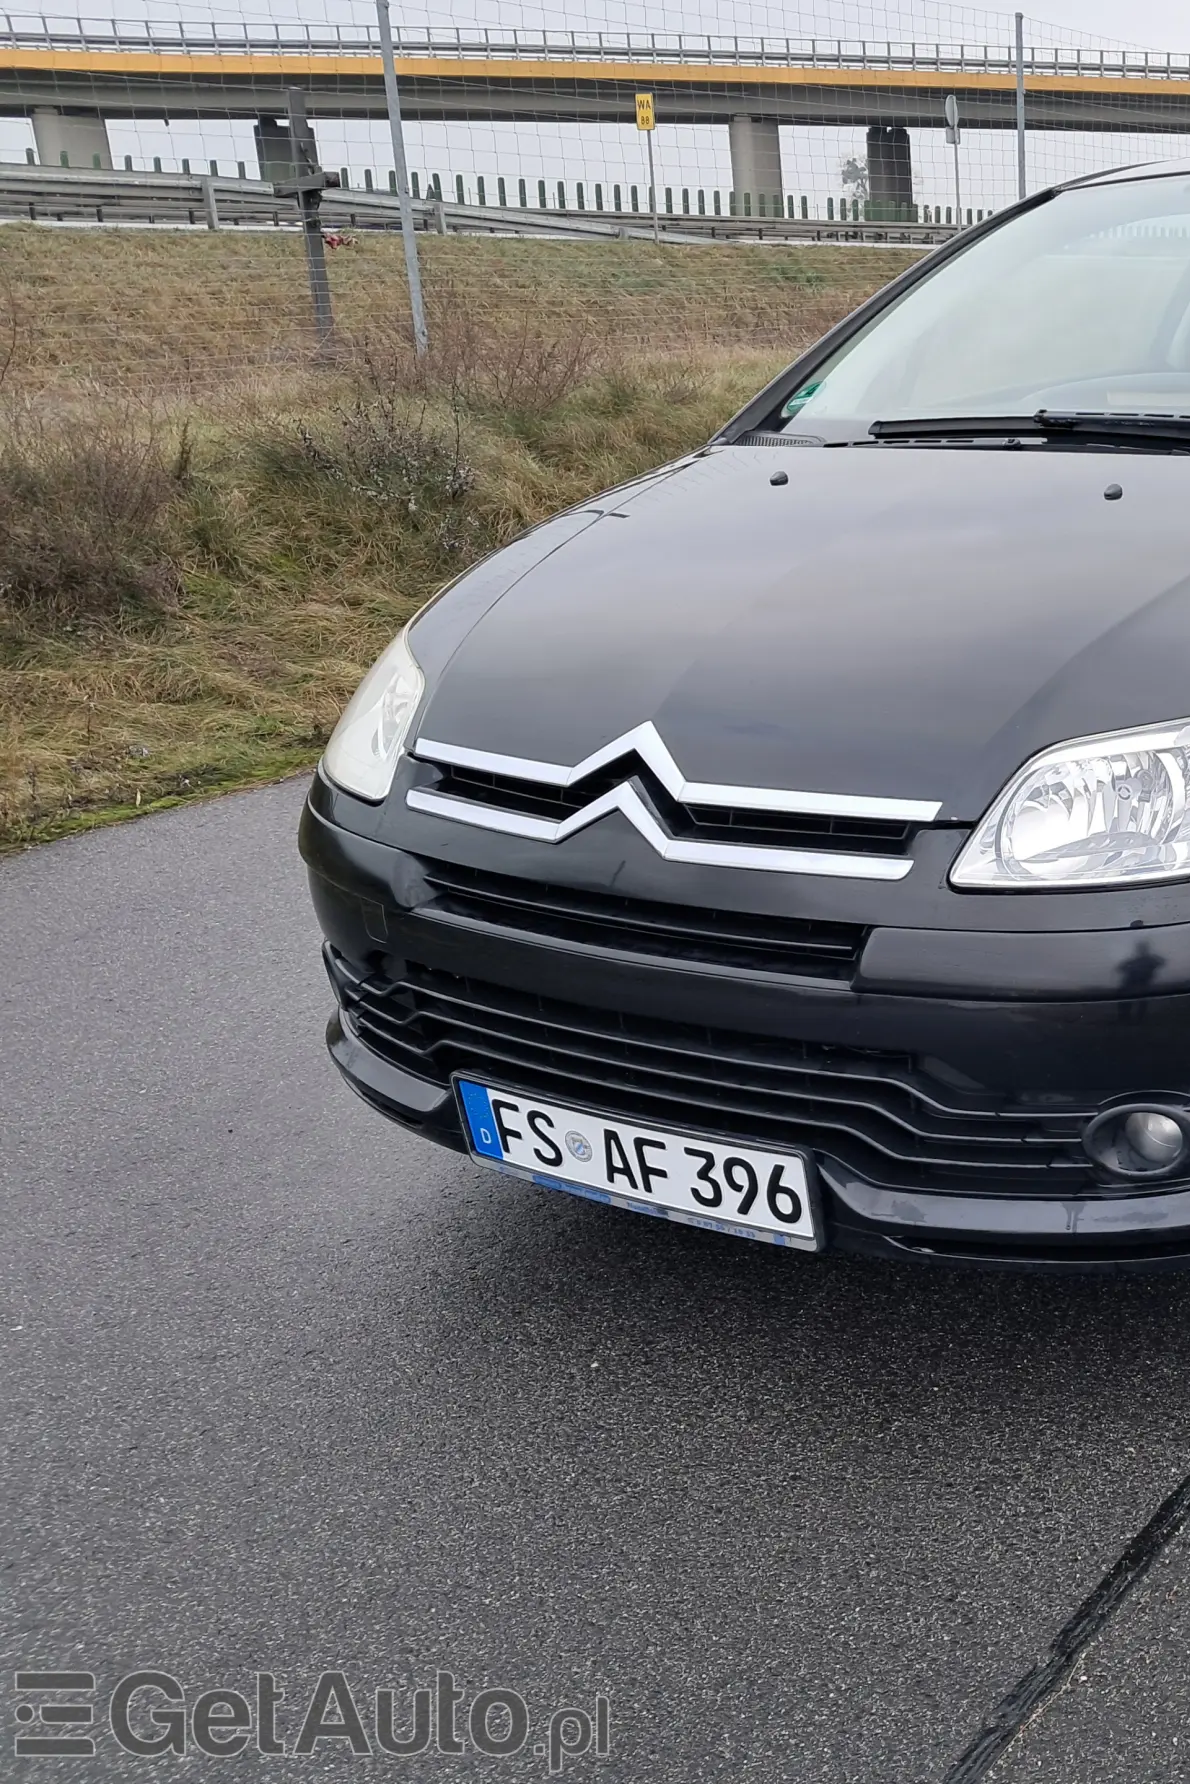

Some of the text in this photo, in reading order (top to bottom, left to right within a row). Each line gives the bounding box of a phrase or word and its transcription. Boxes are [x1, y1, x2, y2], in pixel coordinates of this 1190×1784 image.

[637, 99, 651, 110] WA
[481, 1127, 491, 1144] D
[491, 1098, 563, 1167] FS
[603, 1128, 668, 1193] AF
[683, 1146, 803, 1224] 396
